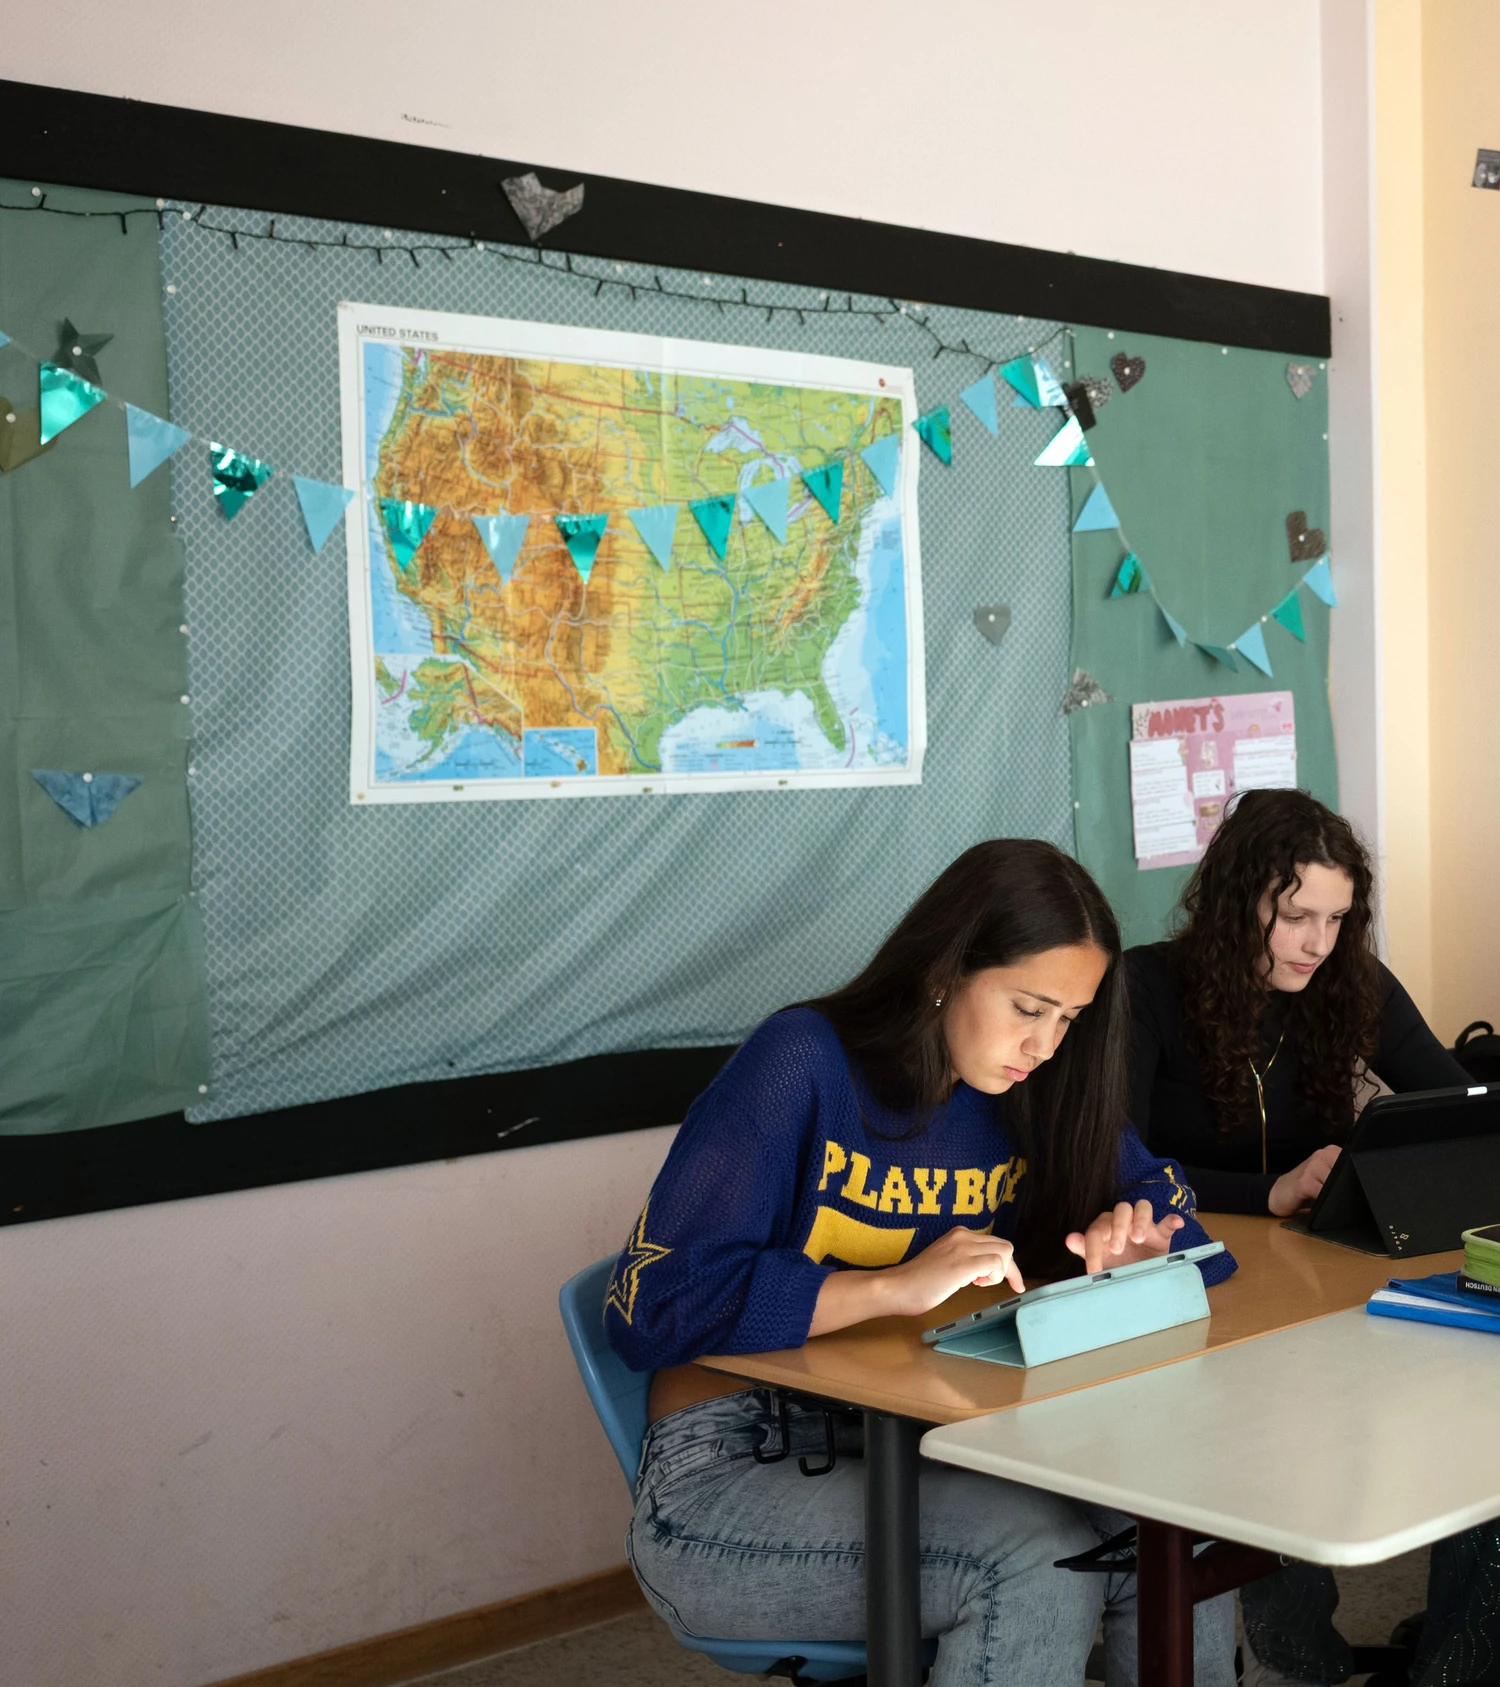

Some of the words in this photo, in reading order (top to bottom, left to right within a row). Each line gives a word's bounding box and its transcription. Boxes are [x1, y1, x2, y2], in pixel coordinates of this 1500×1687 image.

[356, 324, 396, 337] UNITED
[399, 328, 438, 341] STATES
[1465, 1281, 1492, 1292] DEUTSCH
